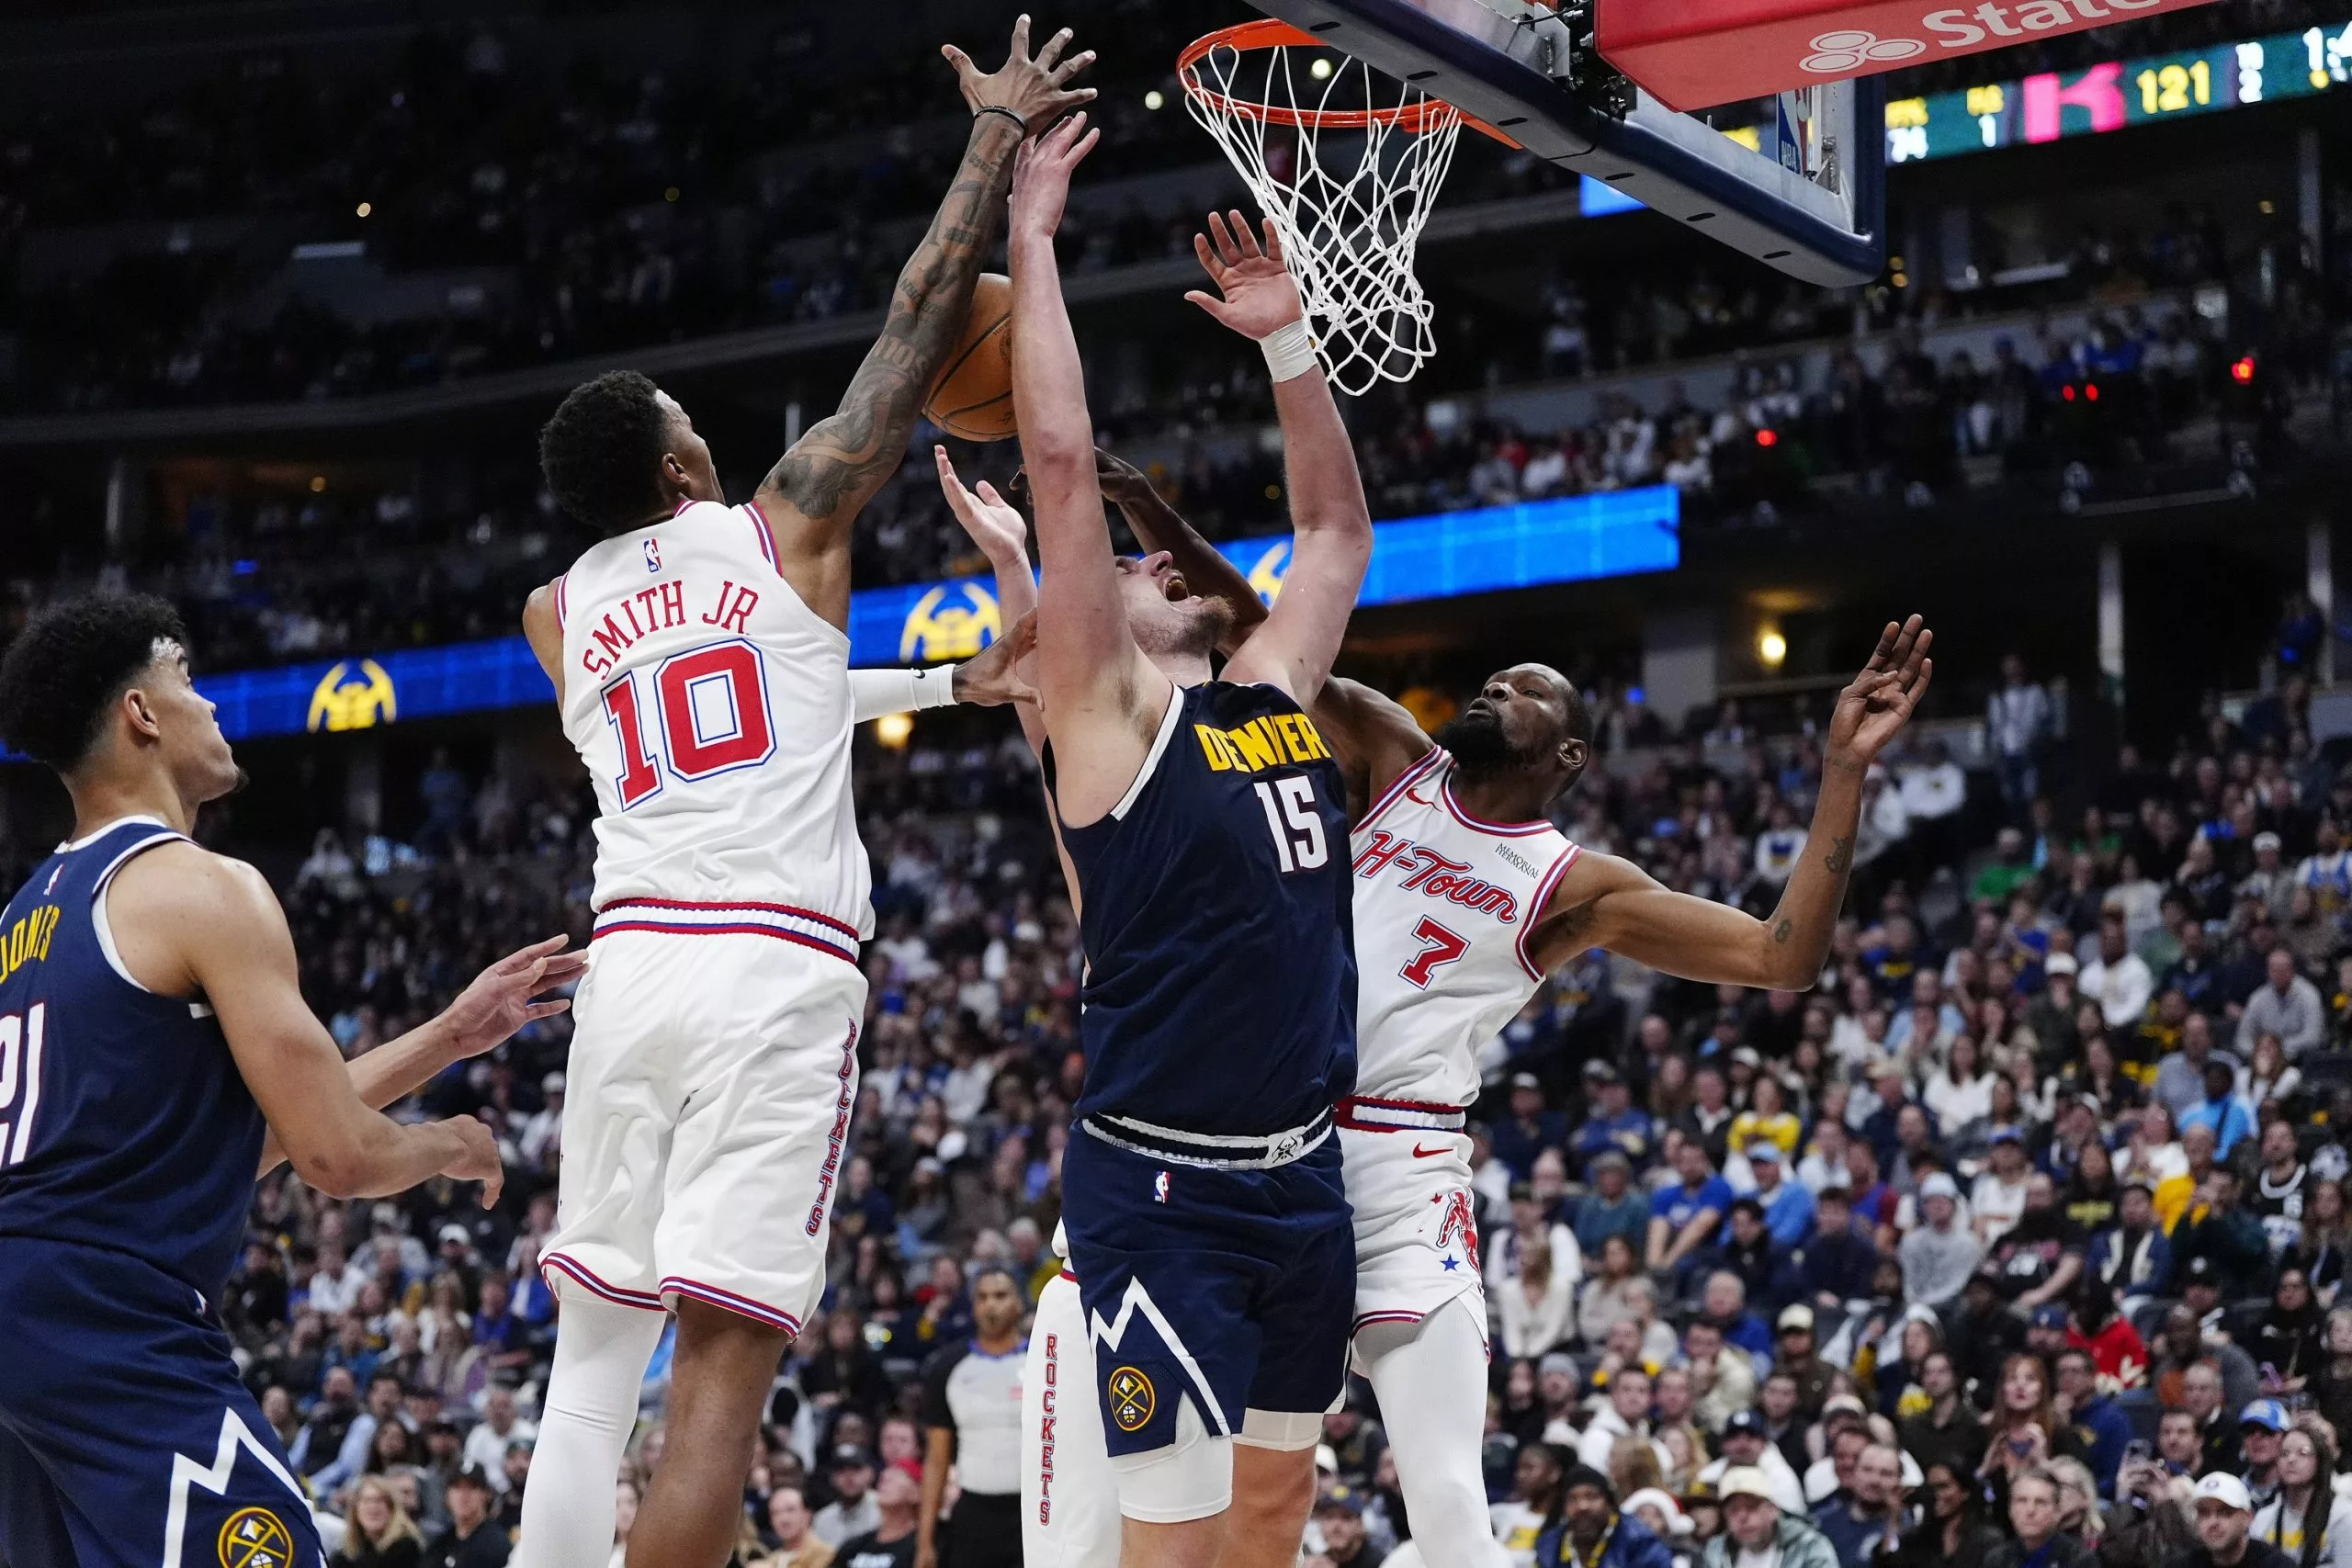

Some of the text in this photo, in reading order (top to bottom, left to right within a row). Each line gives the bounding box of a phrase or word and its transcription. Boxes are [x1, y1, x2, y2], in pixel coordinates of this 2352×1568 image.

[2136, 60, 2211, 114] 121
[582, 580, 759, 681] SMITH JR
[601, 637, 777, 812] 10
[1193, 713, 1331, 773] DENVER
[1253, 775, 1329, 873] 15
[1353, 830, 1518, 924] H-Town
[1398, 914, 1471, 991] 7
[805, 1018, 857, 1236] ROCKETS
[1039, 1334, 1058, 1526] ROCKETS
